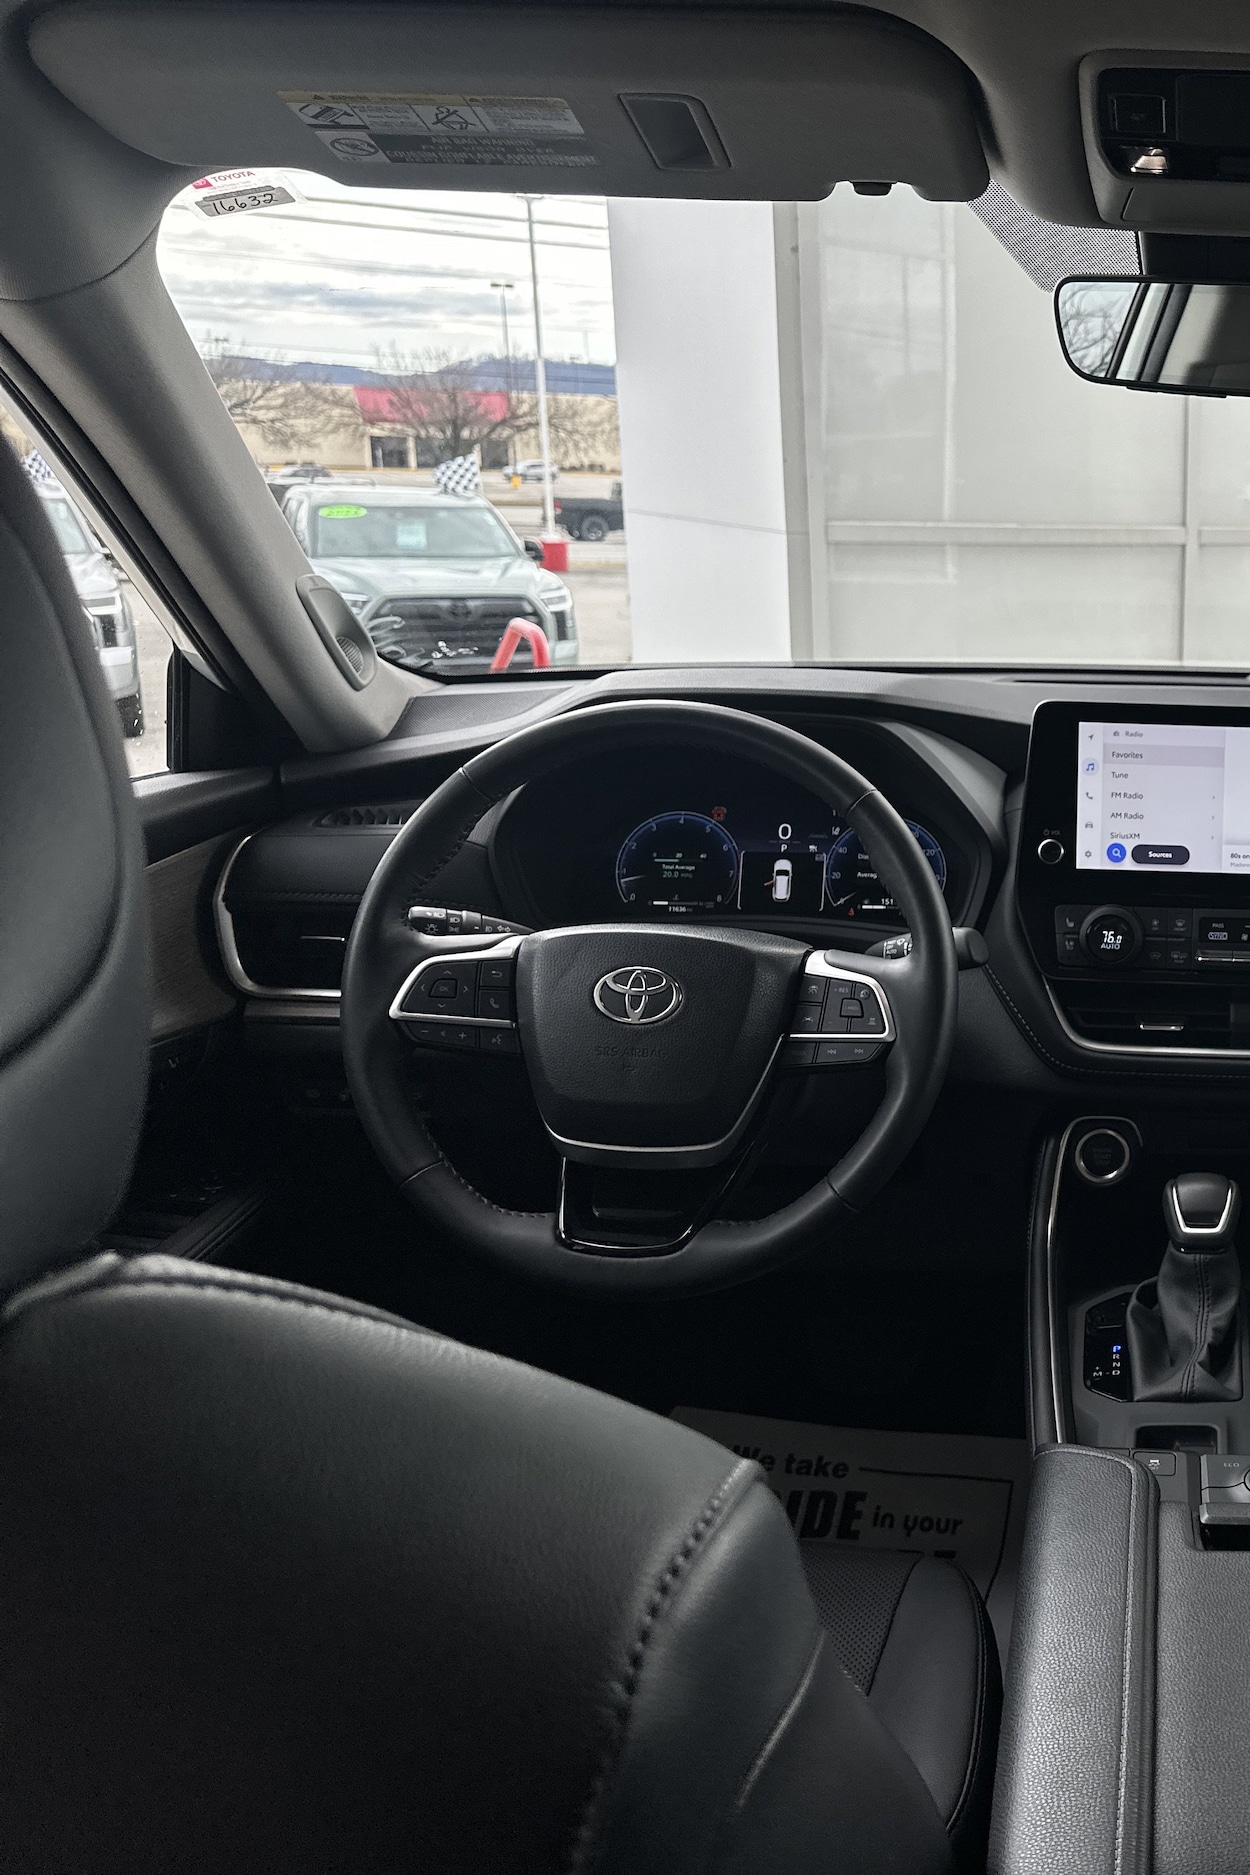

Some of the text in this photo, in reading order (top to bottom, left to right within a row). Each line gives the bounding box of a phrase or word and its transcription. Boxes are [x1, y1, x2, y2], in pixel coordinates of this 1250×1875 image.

[210, 170, 256, 183] TOYOTA
[213, 193, 279, 215] 16632
[1125, 730, 1144, 738] Radio
[1111, 751, 1144, 759] Favorites
[1111, 771, 1129, 779] Tune
[1110, 791, 1144, 800] FM Radio
[1110, 812, 1145, 820] AM Radio
[777, 823, 793, 840] 0
[1110, 832, 1141, 840] SiriusXM
[780, 844, 788, 853] P
[837, 846, 848, 854] 40
[1148, 851, 1173, 859] Sources
[662, 870, 679, 879] 20.0
[831, 872, 842, 880] 20
[857, 871, 878, 880] Averag
[1102, 930, 1123, 944] 76.0
[1113, 1345, 1122, 1353] P
[784, 1453, 850, 1479] take
[779, 1490, 963, 1541] IDE in your
